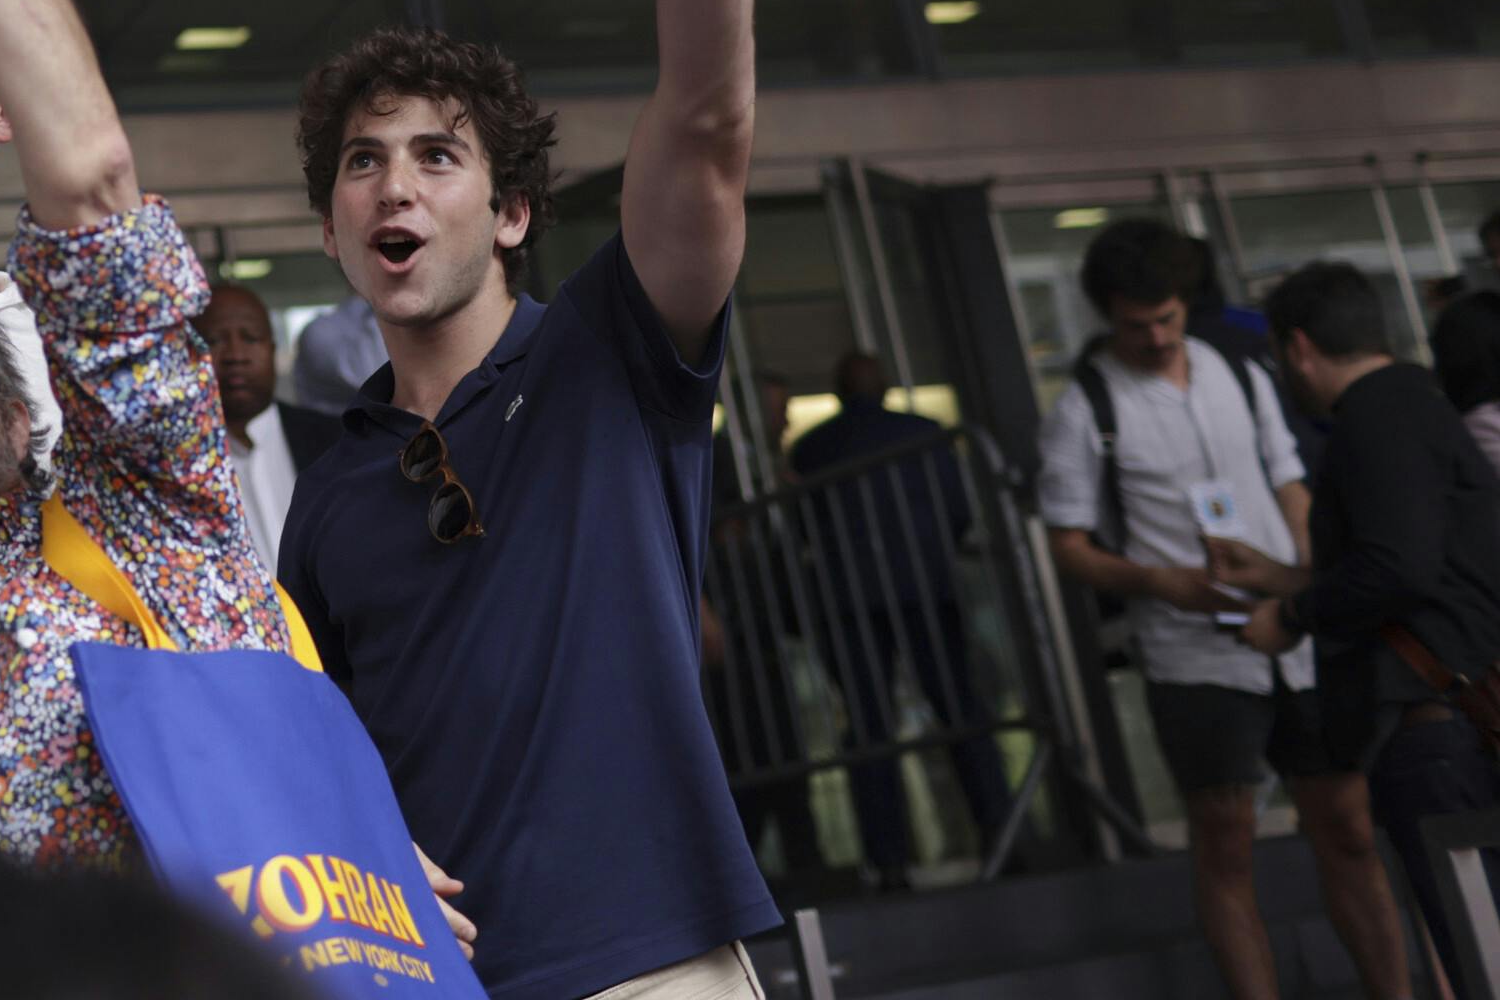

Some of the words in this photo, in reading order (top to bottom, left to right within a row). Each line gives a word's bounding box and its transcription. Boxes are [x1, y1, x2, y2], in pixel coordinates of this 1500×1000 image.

[300, 937, 364, 973] NEW
[364, 942, 405, 975] YORK
[401, 954, 436, 984] CITY
